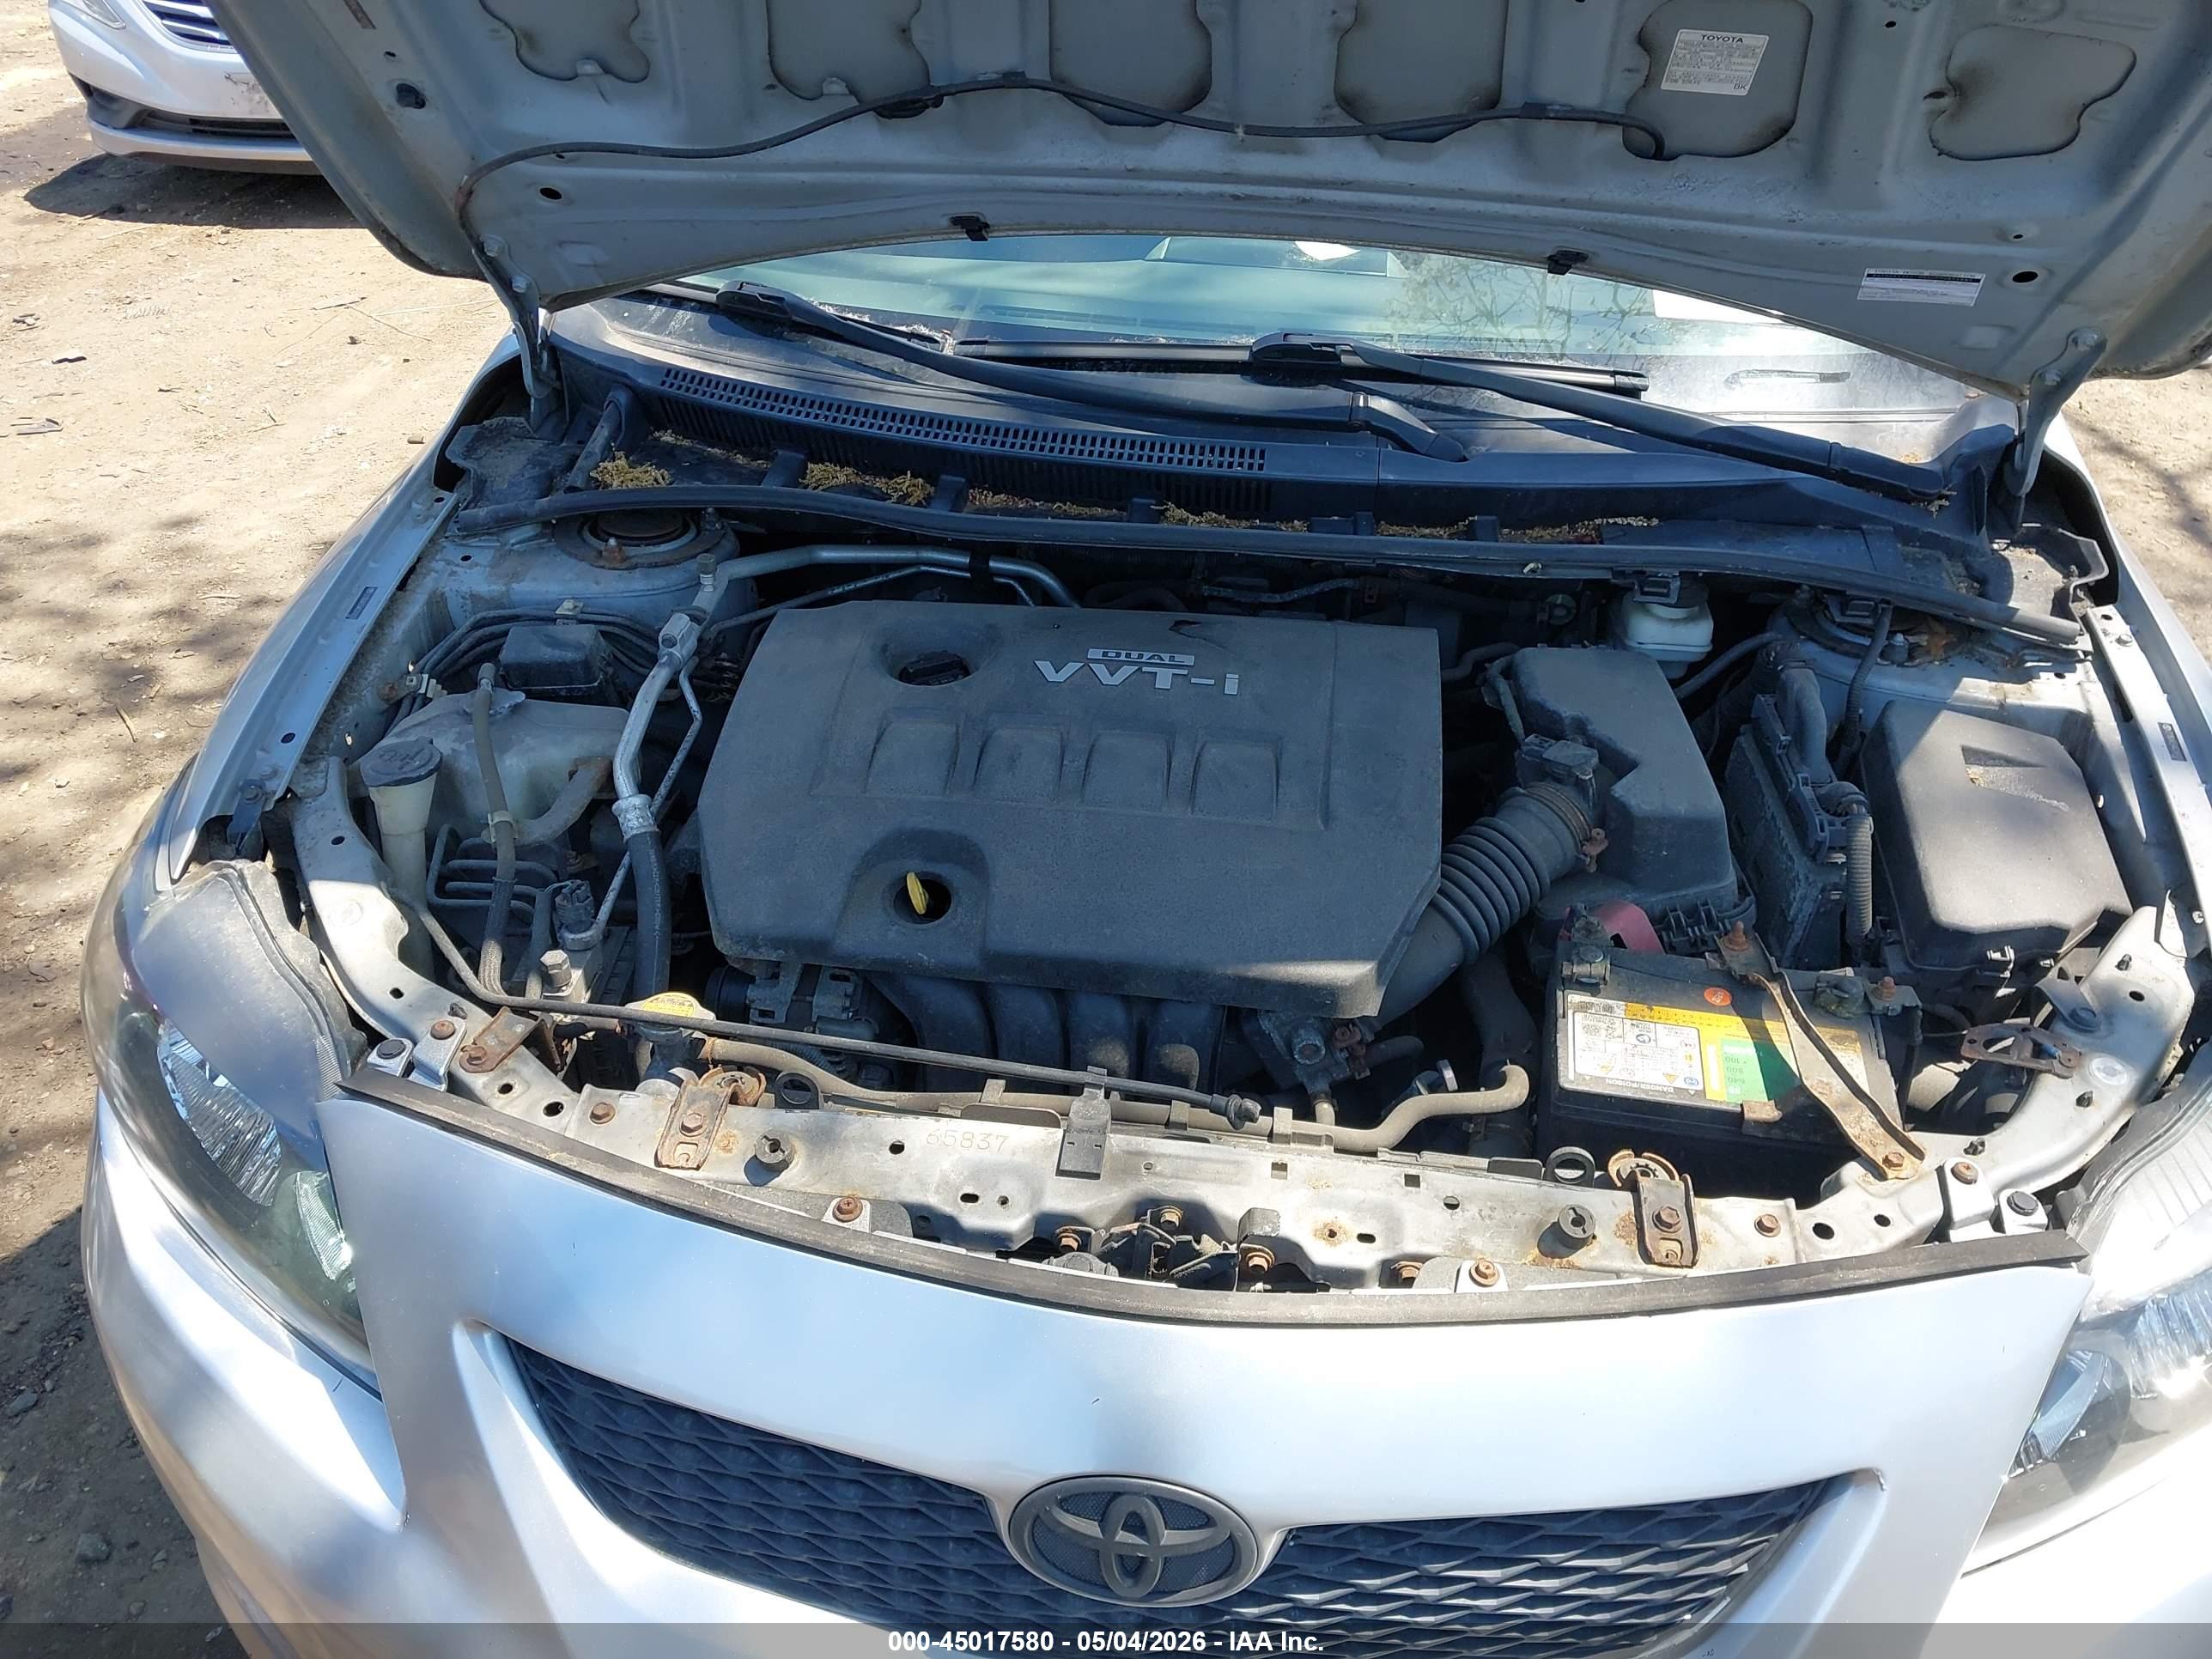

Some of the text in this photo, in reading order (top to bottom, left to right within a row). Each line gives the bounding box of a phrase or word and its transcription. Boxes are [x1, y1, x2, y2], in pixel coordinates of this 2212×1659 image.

[1700, 34, 1744, 44] TOYOTA
[1101, 650, 1185, 663] DUAL
[1034, 659, 1239, 696] VVT-i
[926, 1128, 1010, 1153] 65837
